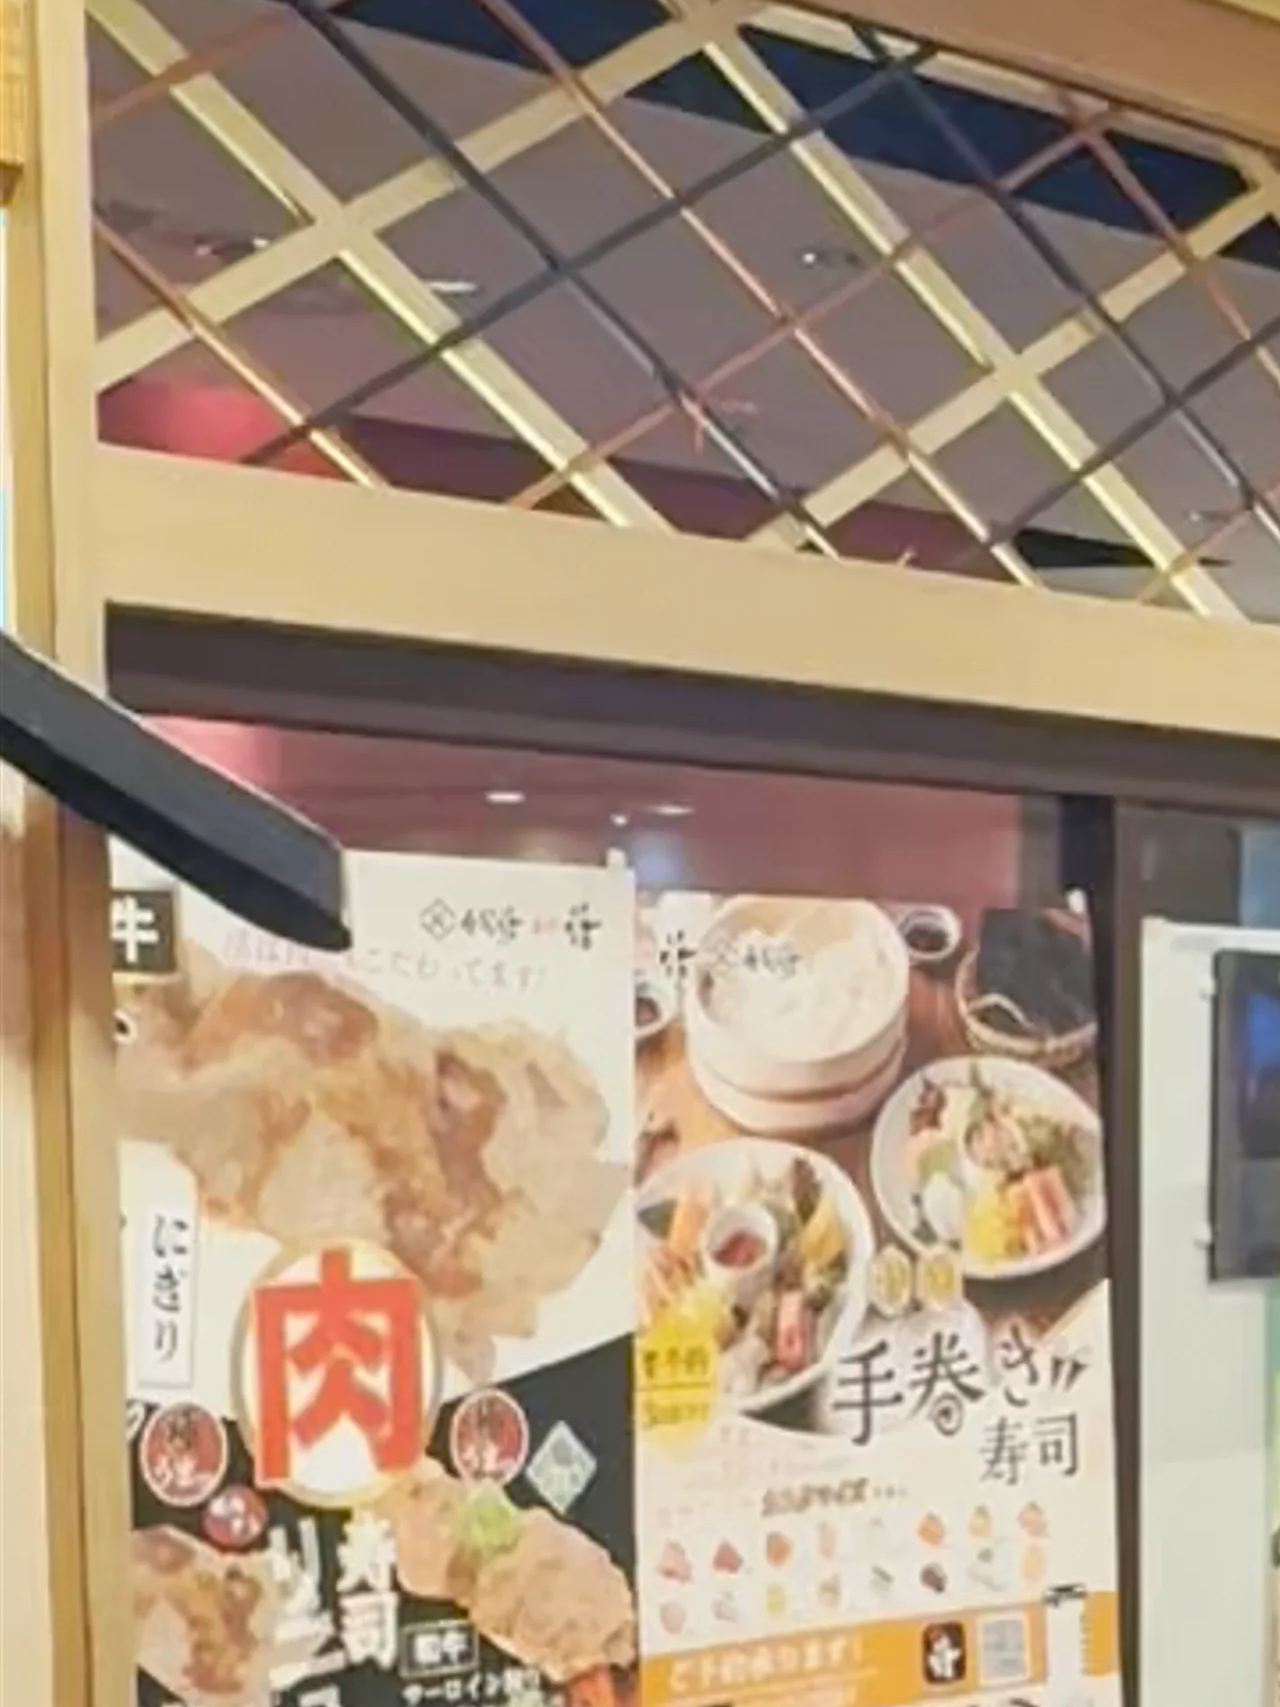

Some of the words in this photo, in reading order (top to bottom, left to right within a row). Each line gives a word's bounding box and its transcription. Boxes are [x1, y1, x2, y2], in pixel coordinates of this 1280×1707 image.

[151, 1213, 191, 1365] にぎり
[255, 1248, 422, 1489] 肉
[980, 1411, 1080, 1487] 寿司
[336, 1505, 401, 1671] 寿司
